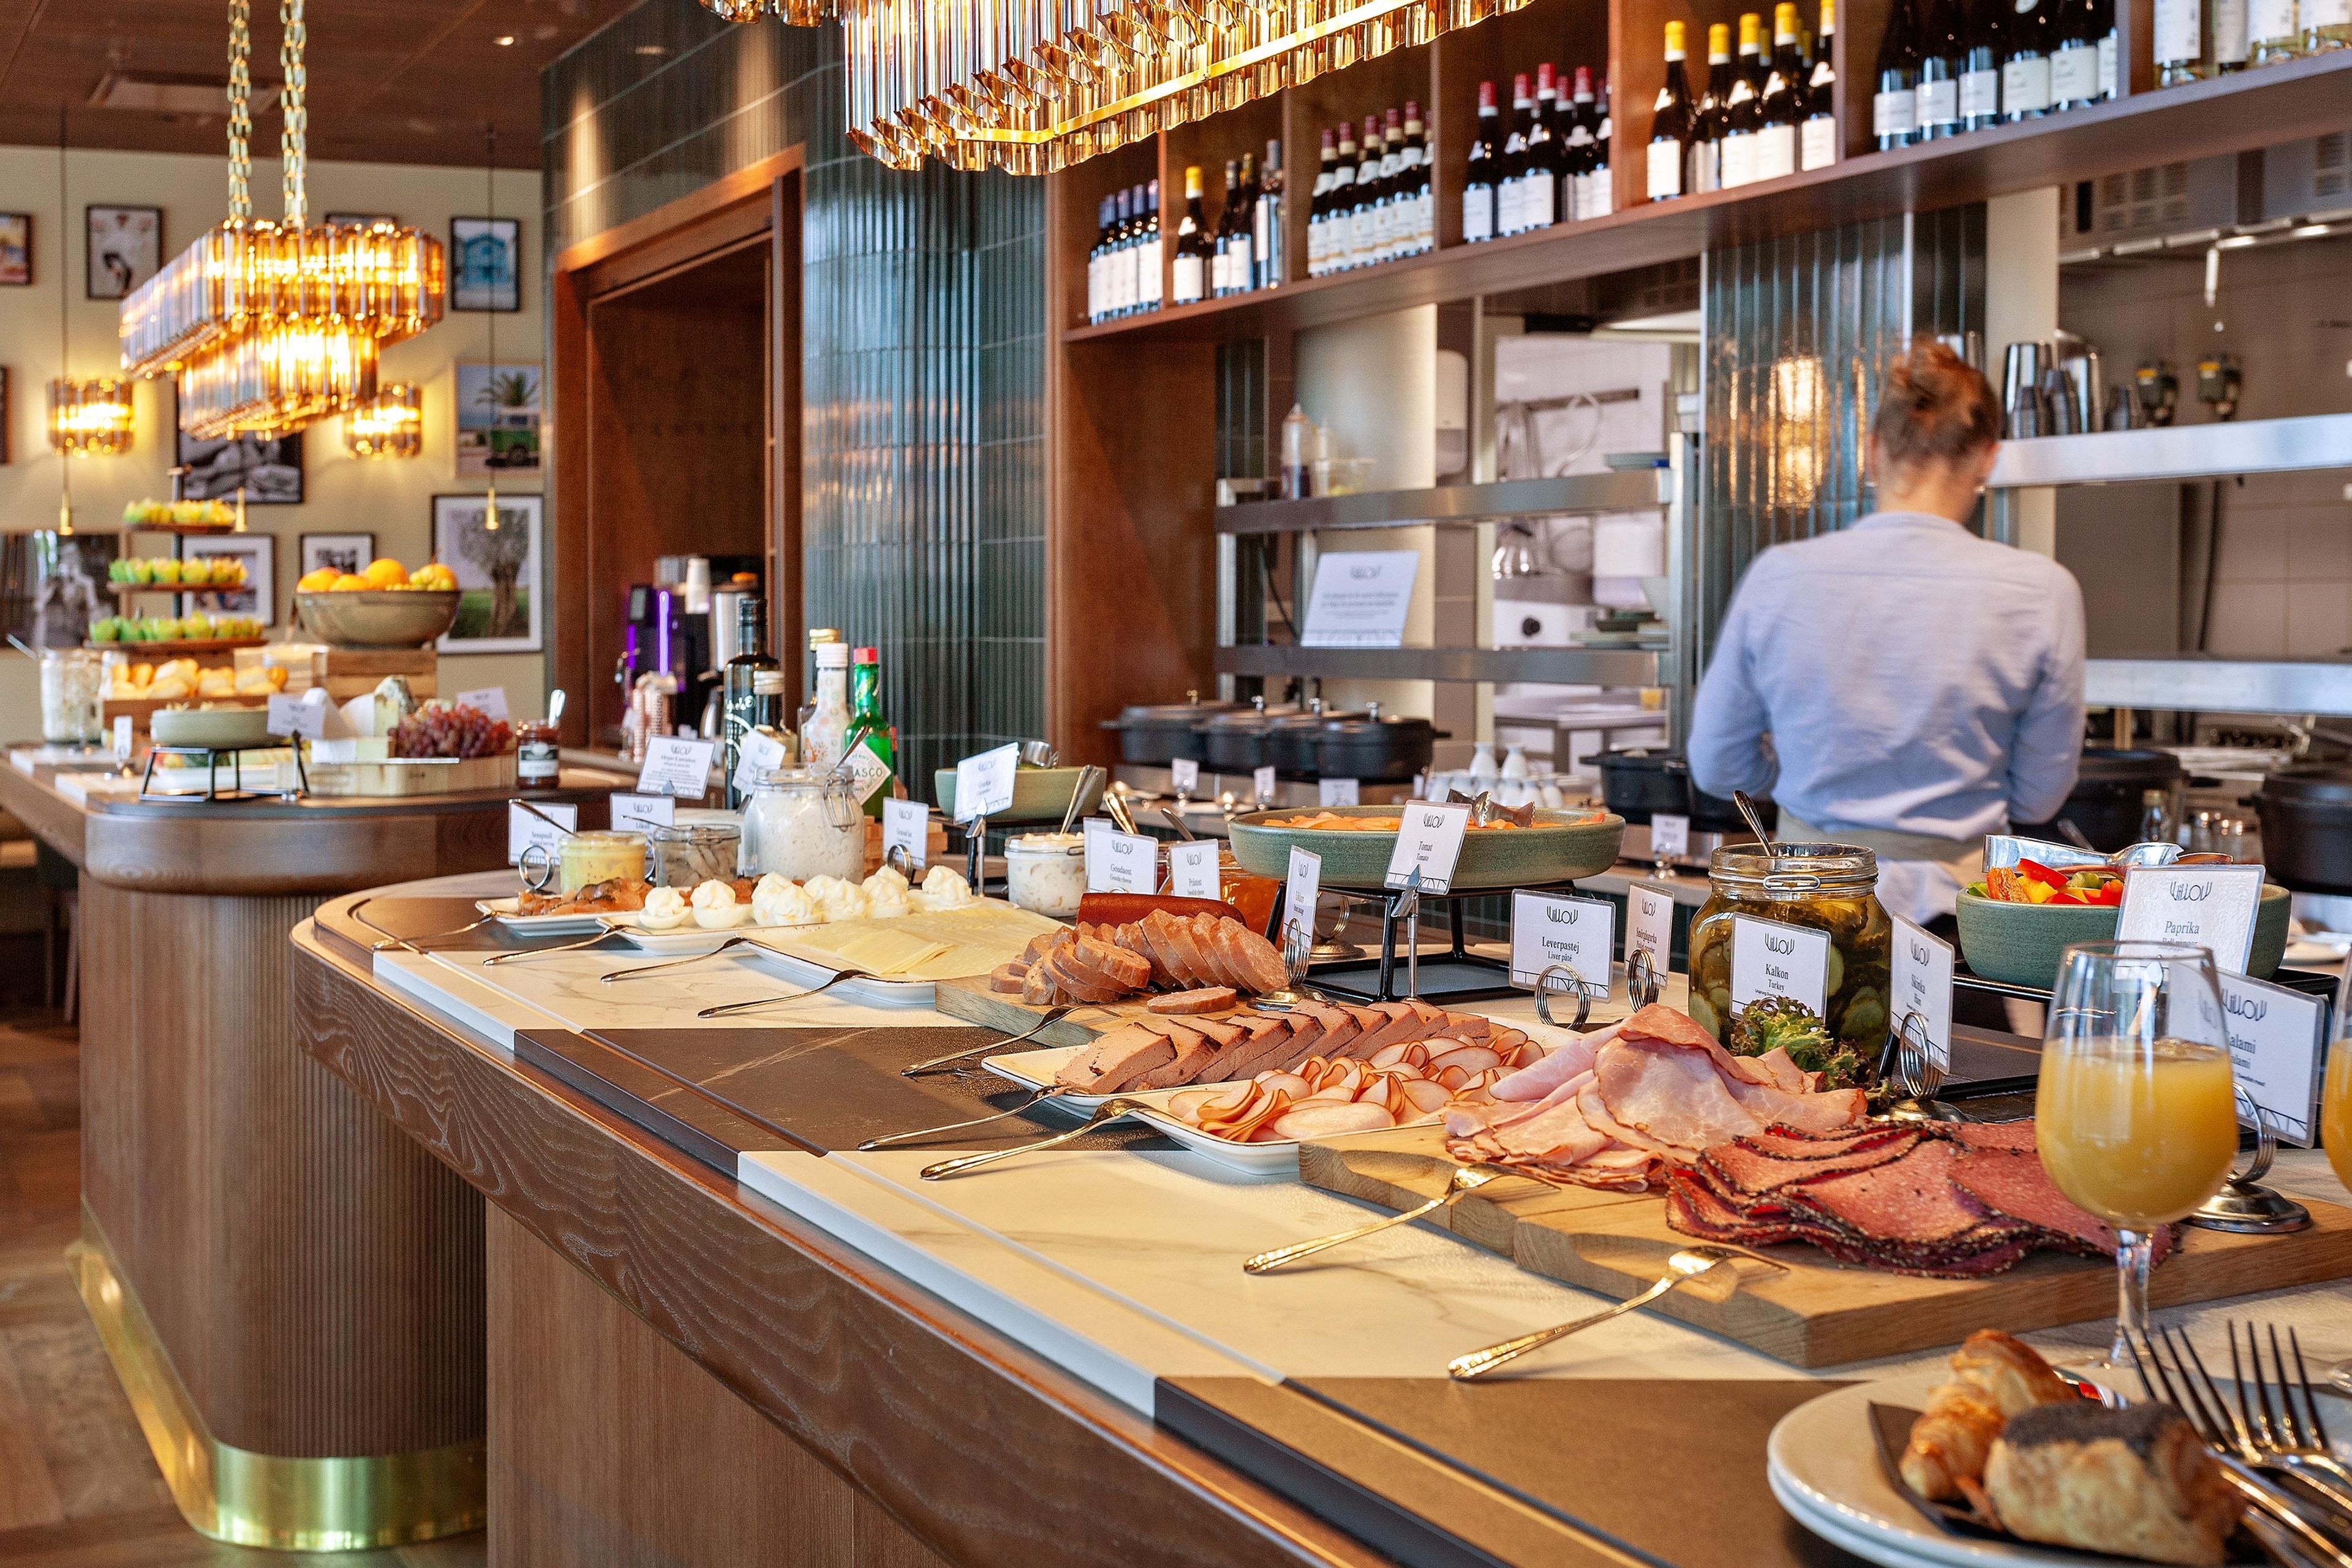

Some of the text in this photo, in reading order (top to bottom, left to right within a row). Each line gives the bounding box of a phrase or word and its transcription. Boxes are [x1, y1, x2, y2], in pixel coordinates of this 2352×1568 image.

[854, 767, 883, 778] ASCO
[1418, 841, 1433, 852] Tomat
[1110, 864, 1132, 875] Goudaost
[1109, 874, 1121, 883] Gouda
[2164, 920, 2200, 937] Paprika
[1542, 936, 1580, 954] Leverpastej
[1548, 951, 1572, 962] Liver pâté
[1765, 963, 1789, 980] Kalkon
[1768, 979, 1785, 993] Turkey
[2230, 1054, 2251, 1069] alami
